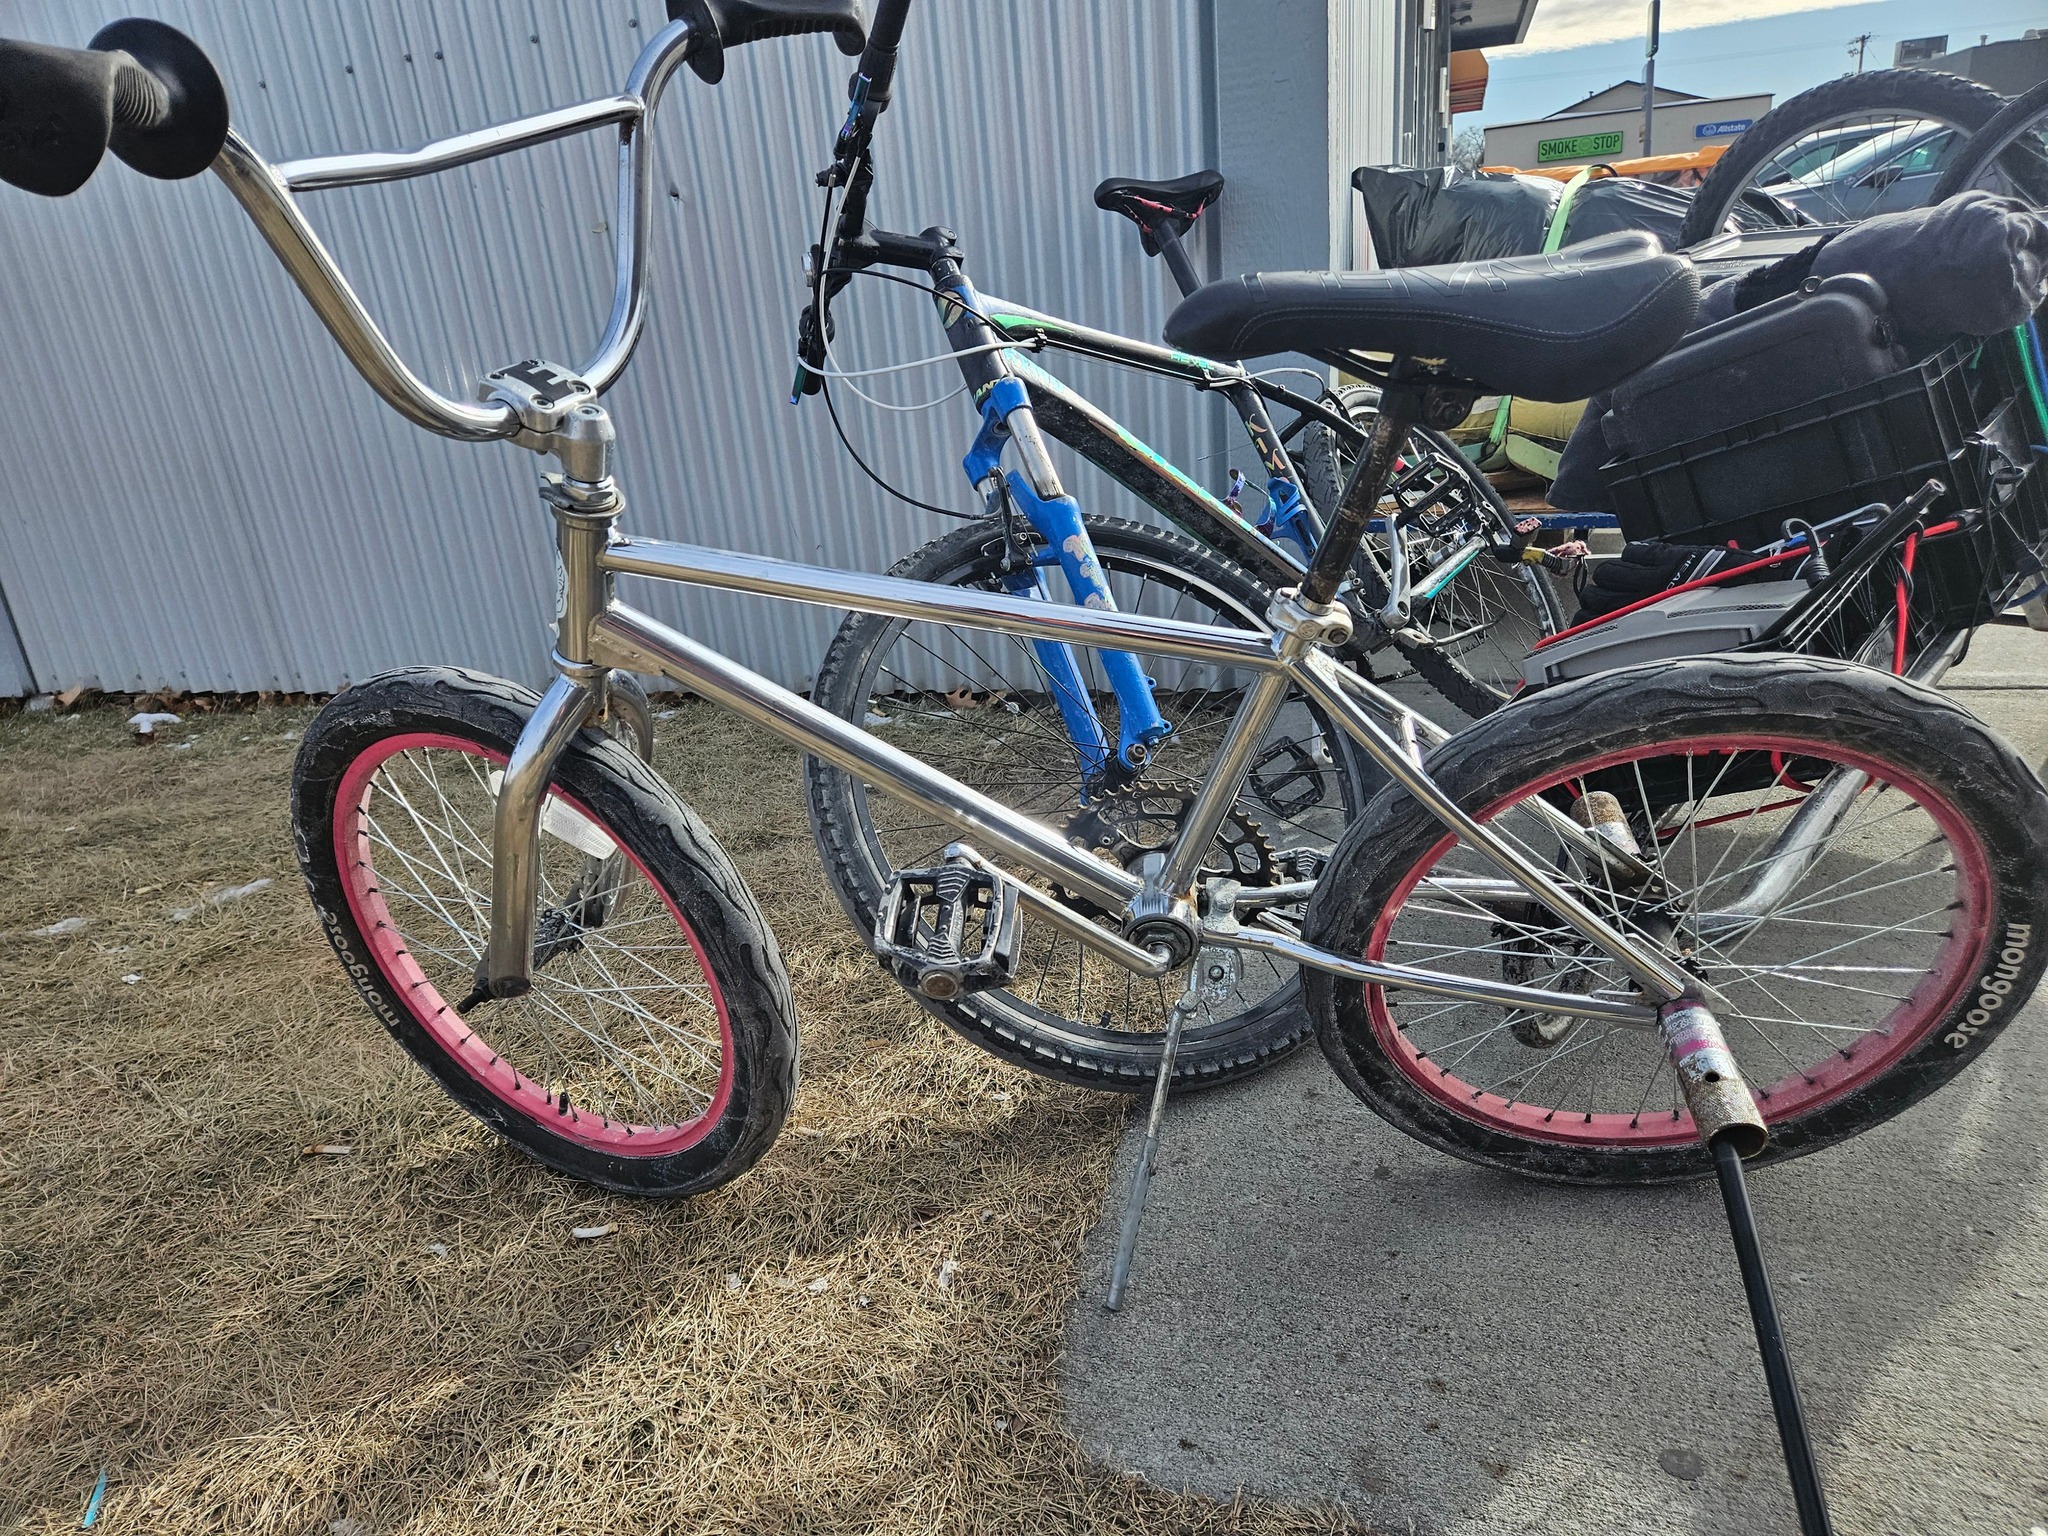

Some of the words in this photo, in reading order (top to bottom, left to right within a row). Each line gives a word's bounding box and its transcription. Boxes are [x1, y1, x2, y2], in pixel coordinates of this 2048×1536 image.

[1541, 139, 1578, 156] SMOKE
[1593, 134, 1620, 150] STOP
[1717, 123, 1746, 133] Allstate
[323, 912, 400, 1027] mongoose
[1943, 922, 2032, 1049] mongoose
